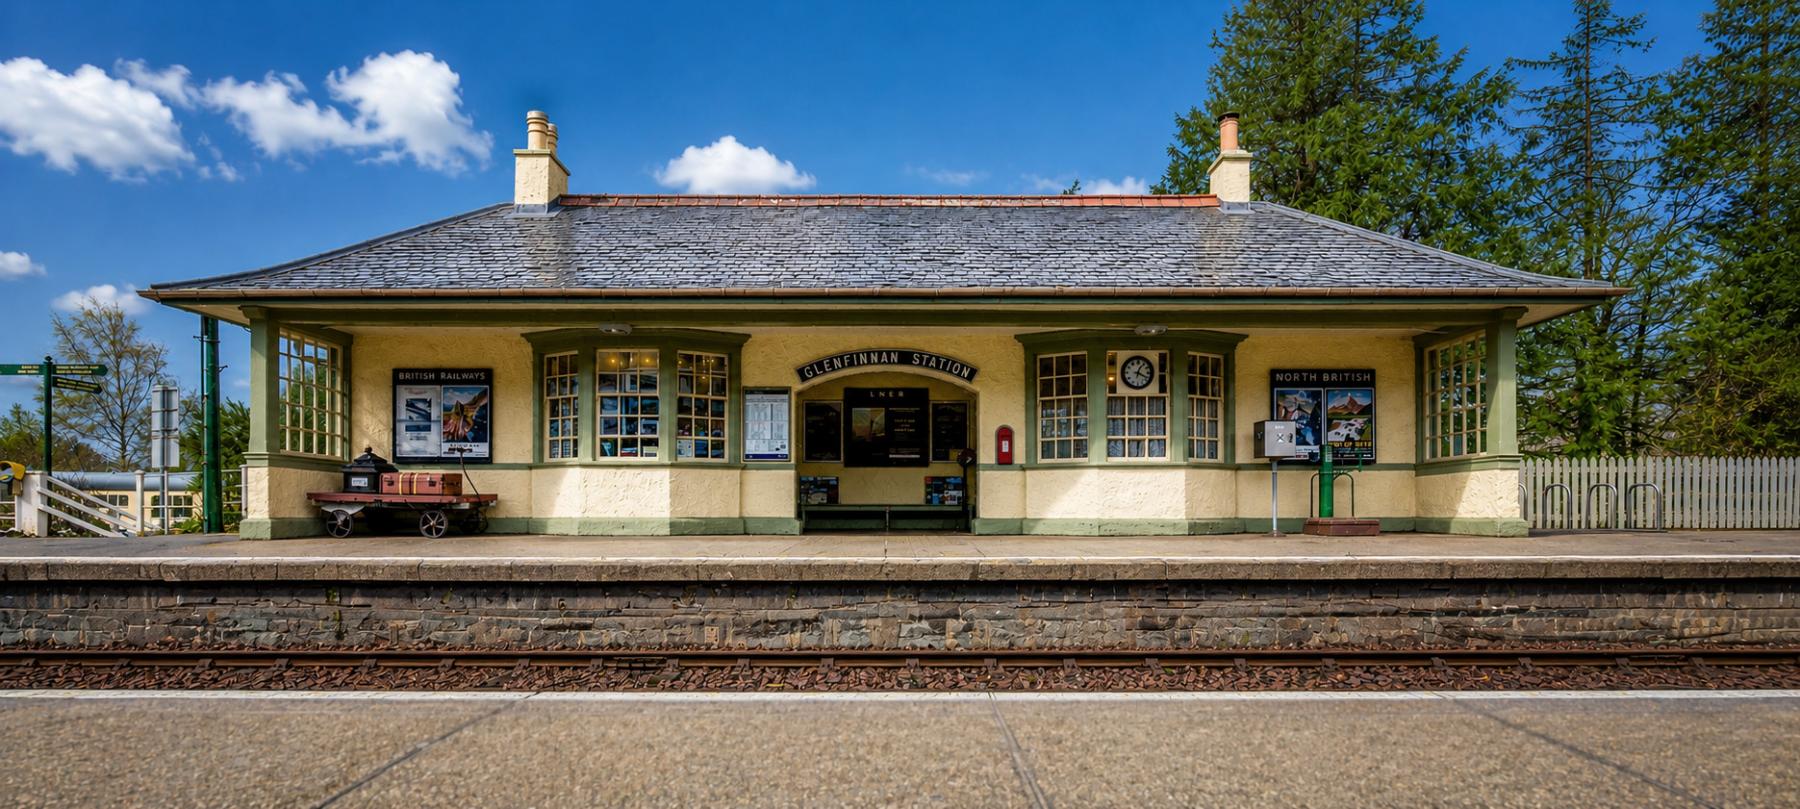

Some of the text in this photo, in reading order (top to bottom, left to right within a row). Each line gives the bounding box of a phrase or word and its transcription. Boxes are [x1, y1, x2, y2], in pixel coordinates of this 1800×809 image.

[804, 352, 971, 378] GLENFINNAN STATION
[398, 372, 486, 380] BRITISH RAILWAYS
[1275, 372, 1371, 381] NORTH BRITISH
